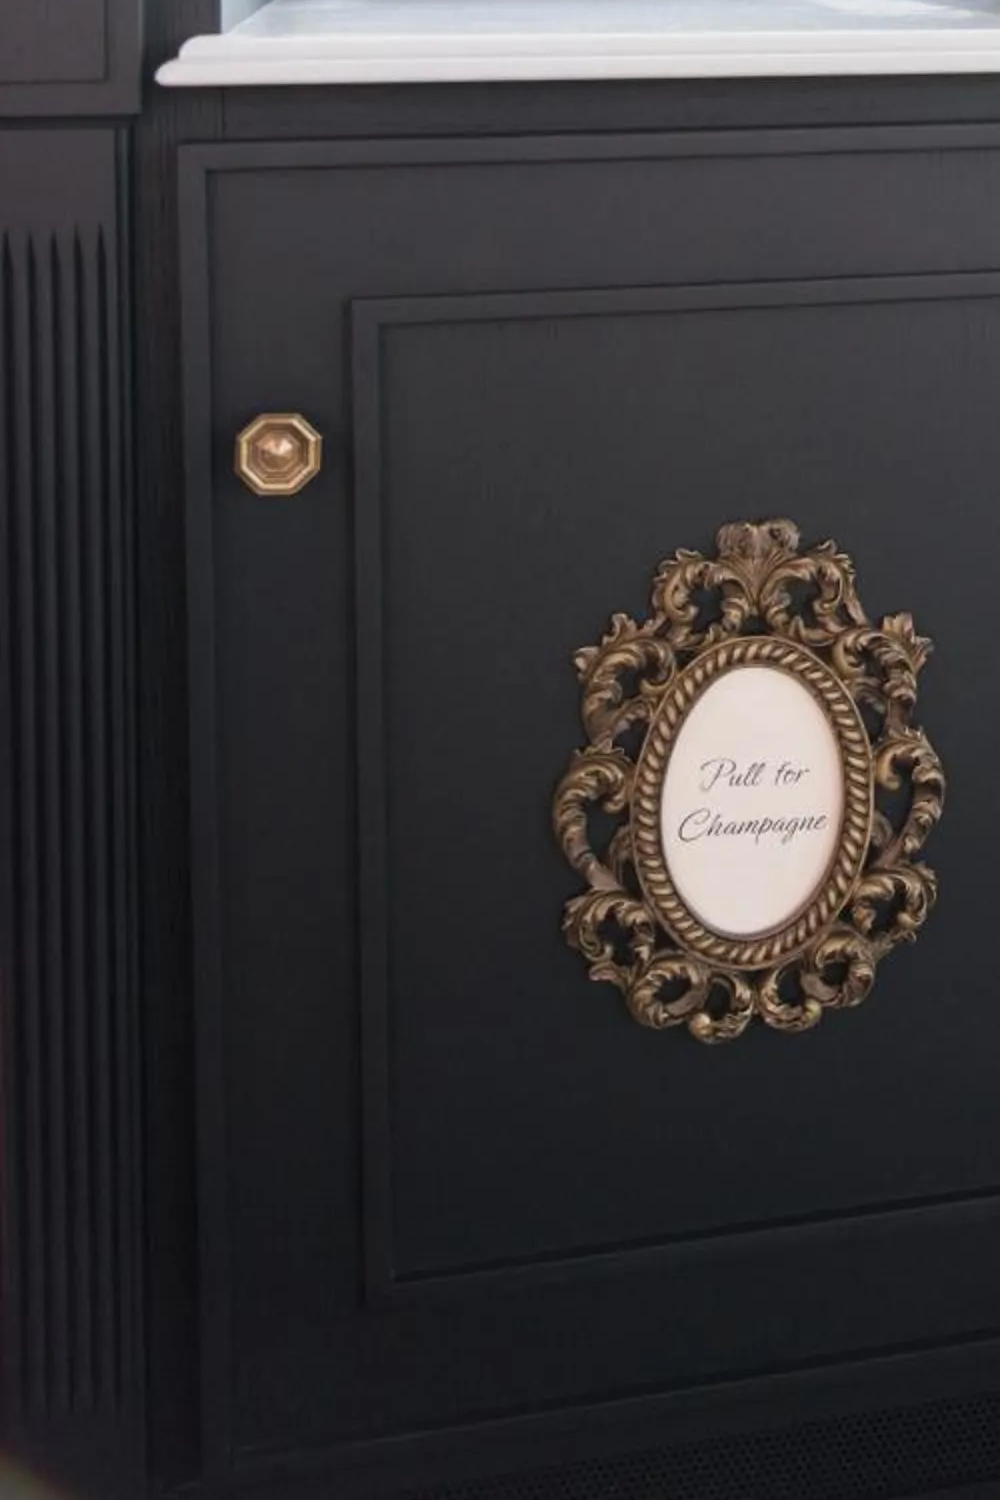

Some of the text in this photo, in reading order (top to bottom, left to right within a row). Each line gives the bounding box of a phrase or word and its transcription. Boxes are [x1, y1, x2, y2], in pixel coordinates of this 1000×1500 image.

[699, 757, 811, 792] Pull for
[678, 807, 828, 845] Champagne
